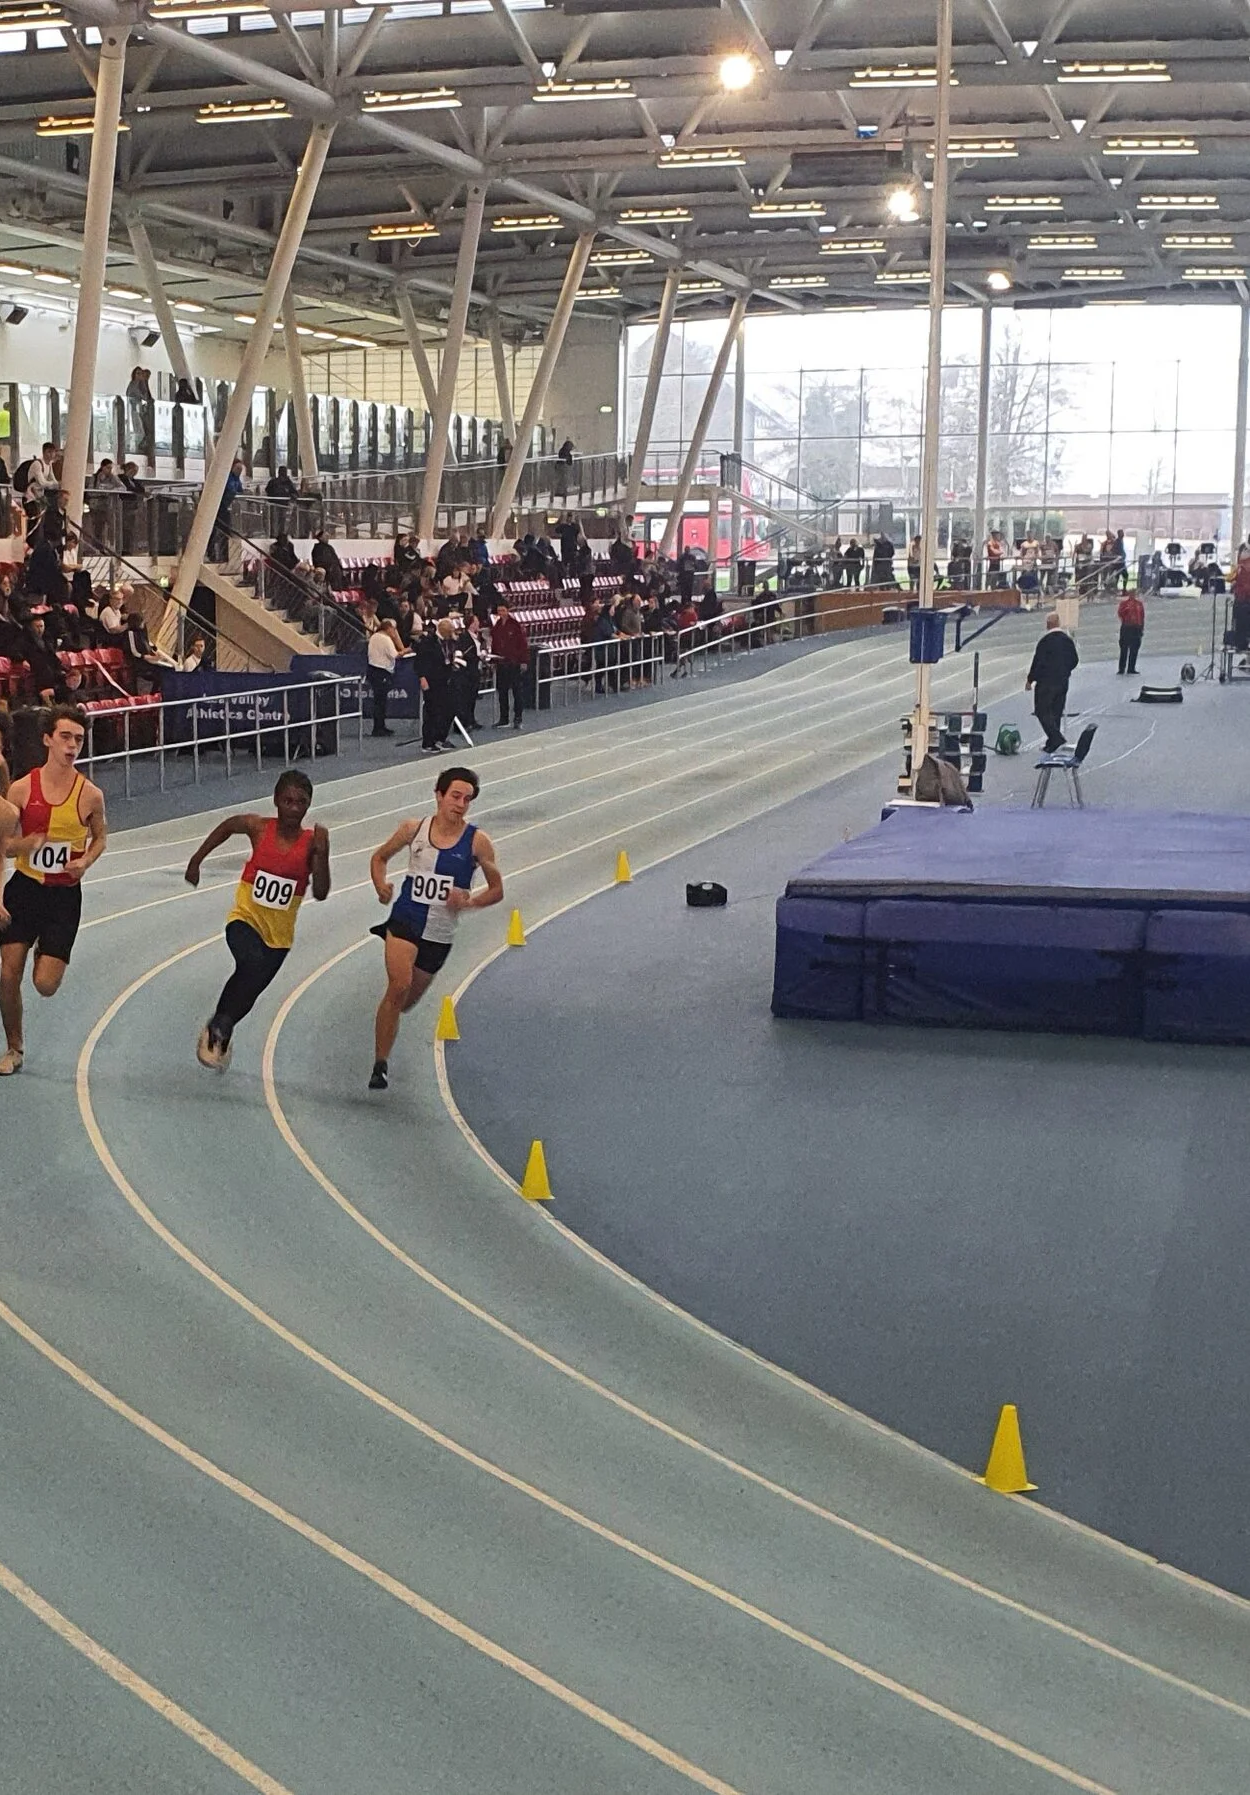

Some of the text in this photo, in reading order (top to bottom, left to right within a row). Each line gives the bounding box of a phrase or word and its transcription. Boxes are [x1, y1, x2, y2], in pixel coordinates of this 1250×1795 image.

[186, 708, 243, 720] Ahletcs
[254, 876, 293, 905] 909
[414, 875, 450, 901] 905
